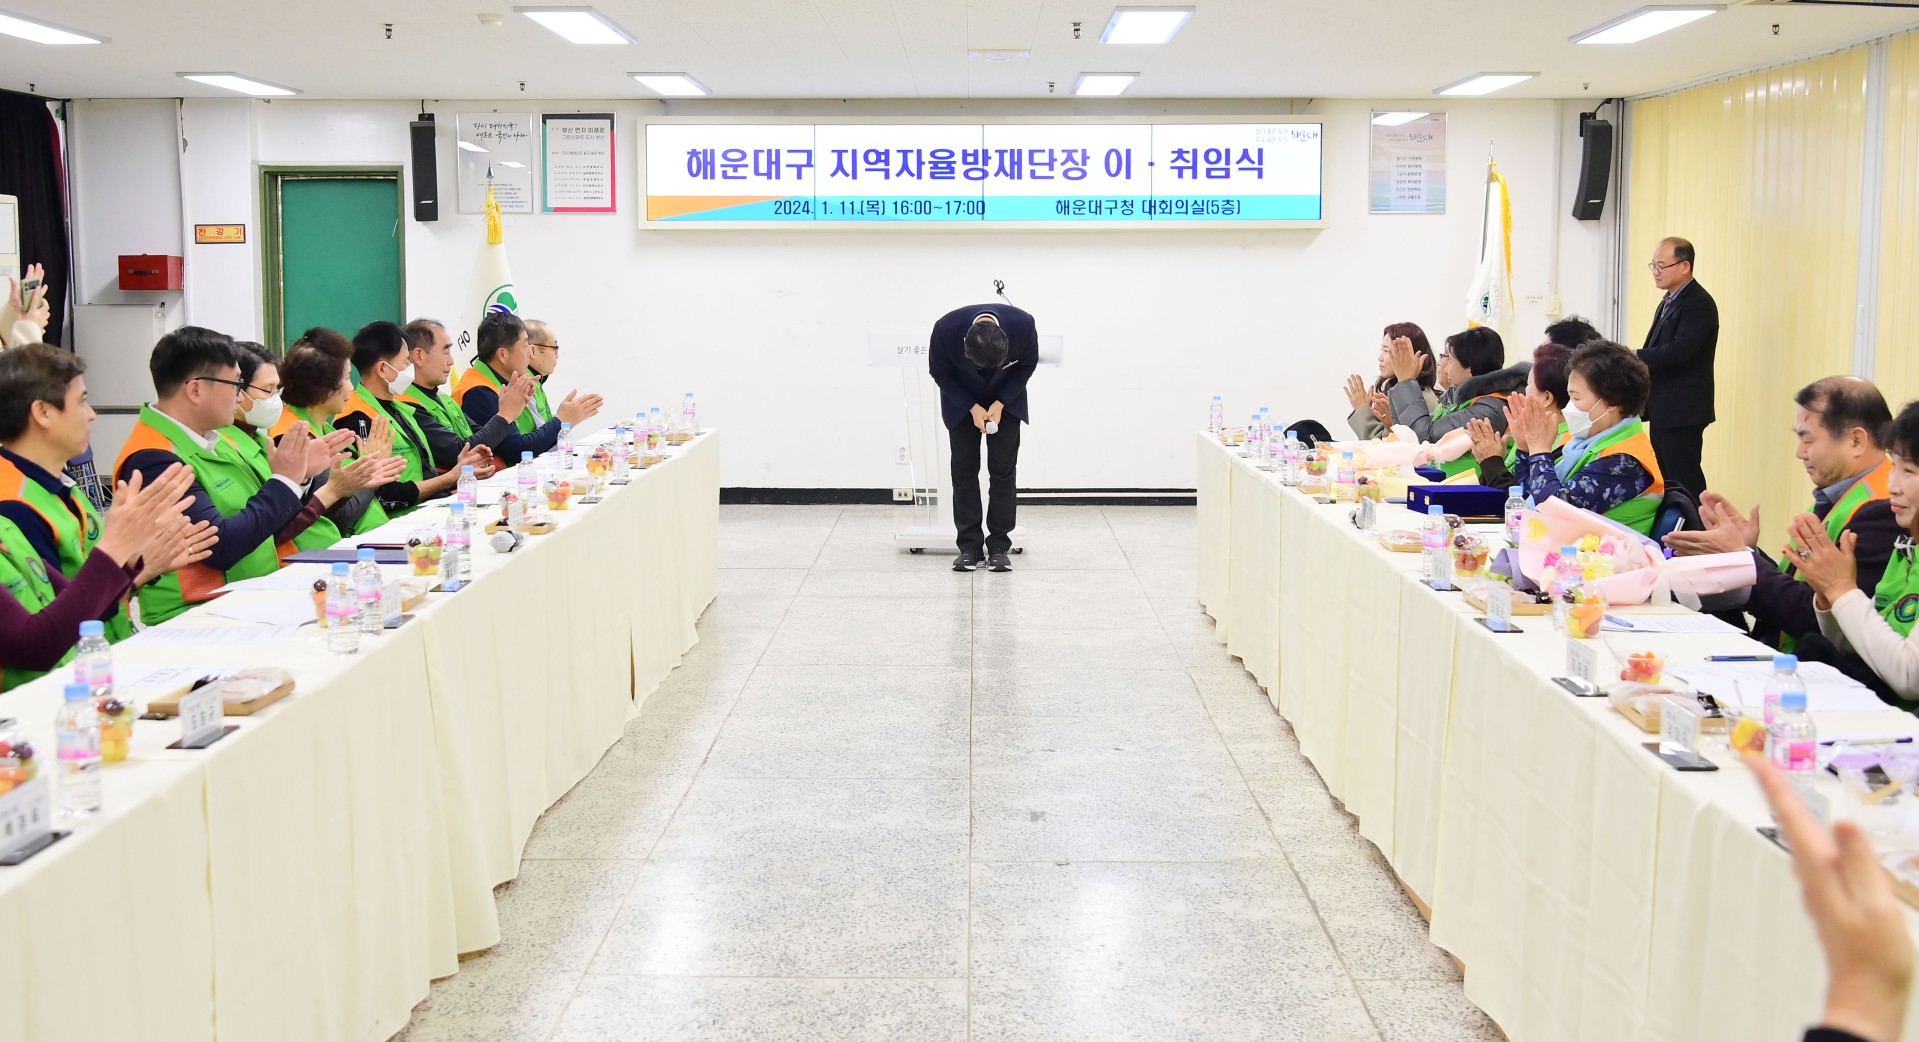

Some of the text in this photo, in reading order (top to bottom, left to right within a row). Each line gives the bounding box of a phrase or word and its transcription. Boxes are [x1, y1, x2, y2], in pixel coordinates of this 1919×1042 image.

[687, 148, 814, 181] 해운대구
[830, 148, 1090, 181] 지역자율방재단장
[1104, 148, 1132, 180] 이
[1170, 147, 1264, 181] 취임식
[774, 200, 986, 216] 2024. 1. 11.(목) 16:00~17:00
[1056, 199, 1241, 216] 해운대구청 대회의실(5층)
[896, 346, 928, 355] 살기 좋은
